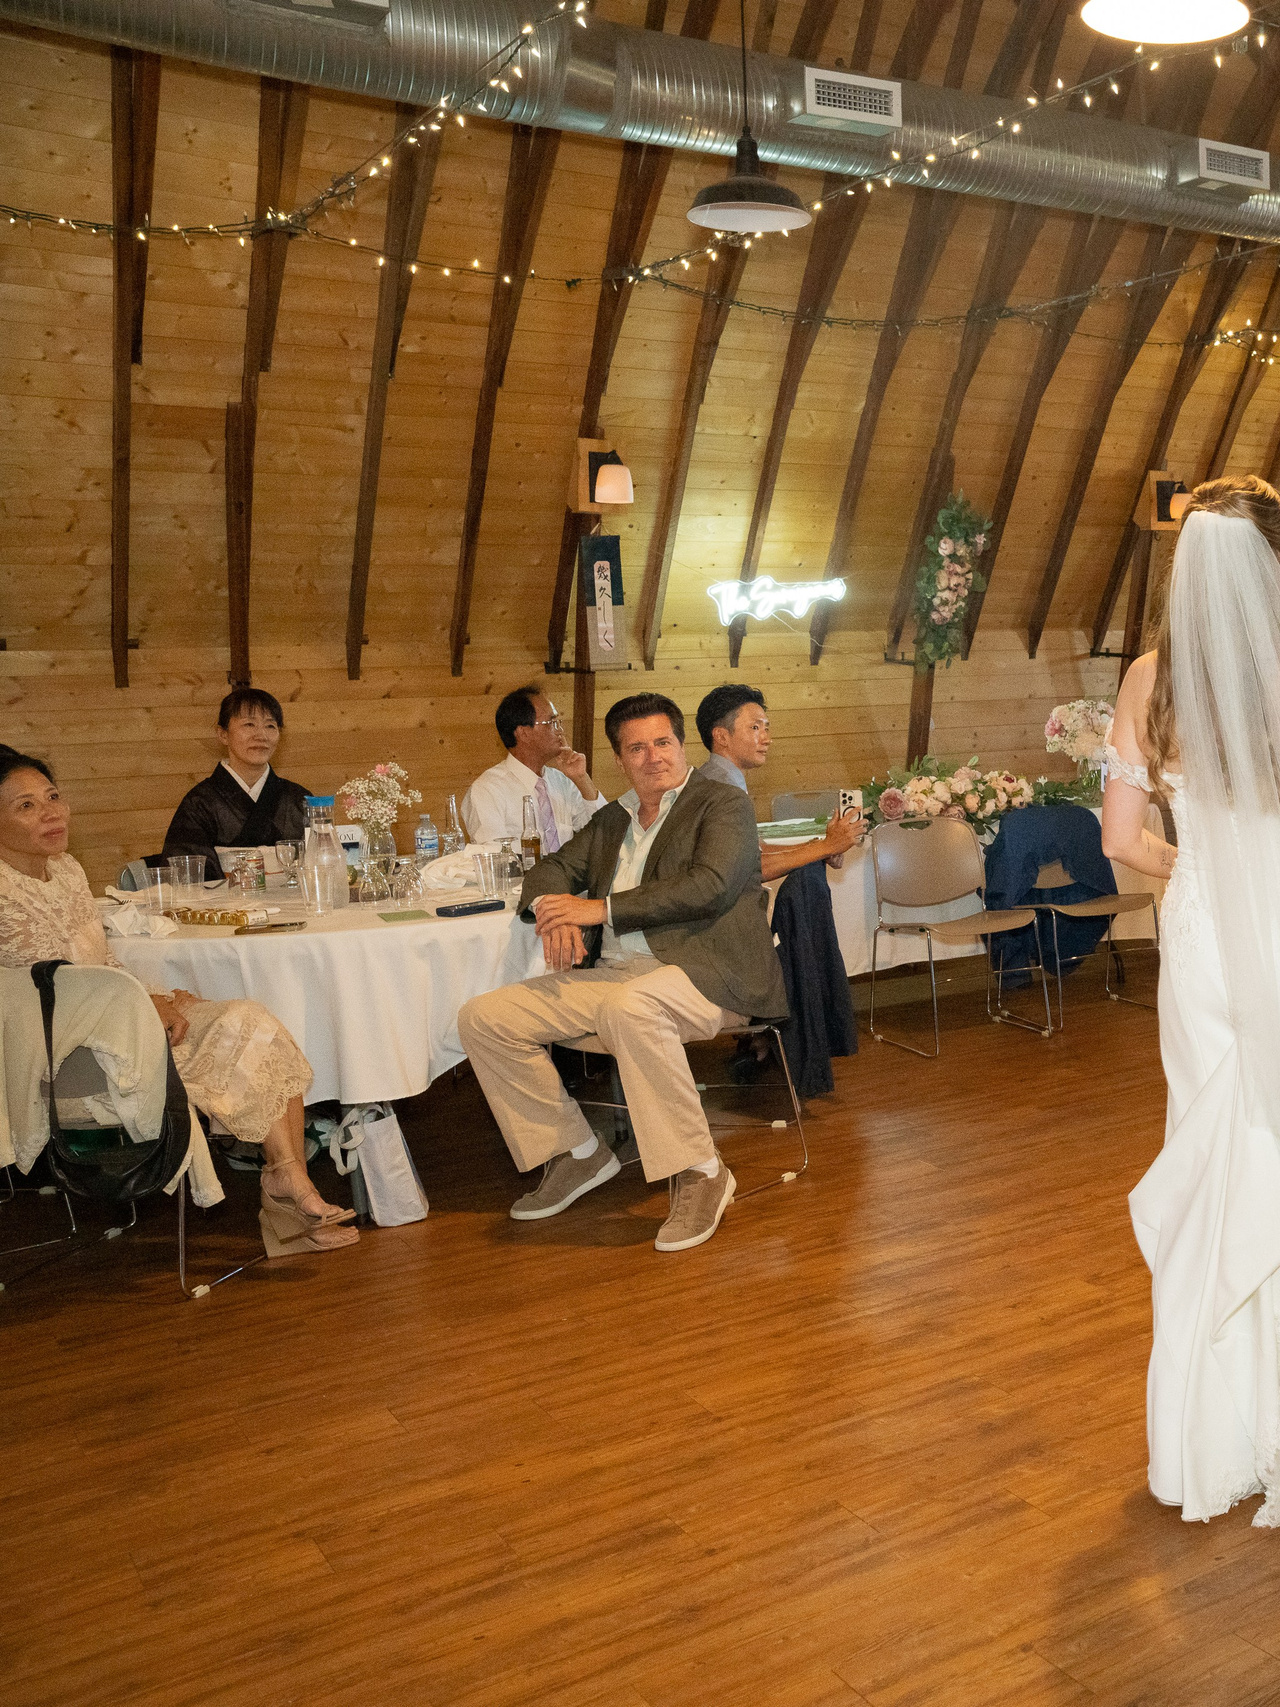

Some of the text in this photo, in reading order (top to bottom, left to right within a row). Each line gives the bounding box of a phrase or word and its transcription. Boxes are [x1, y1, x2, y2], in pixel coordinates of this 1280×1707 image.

[597, 564, 613, 648] 幾久しく
[709, 582, 751, 625] The
